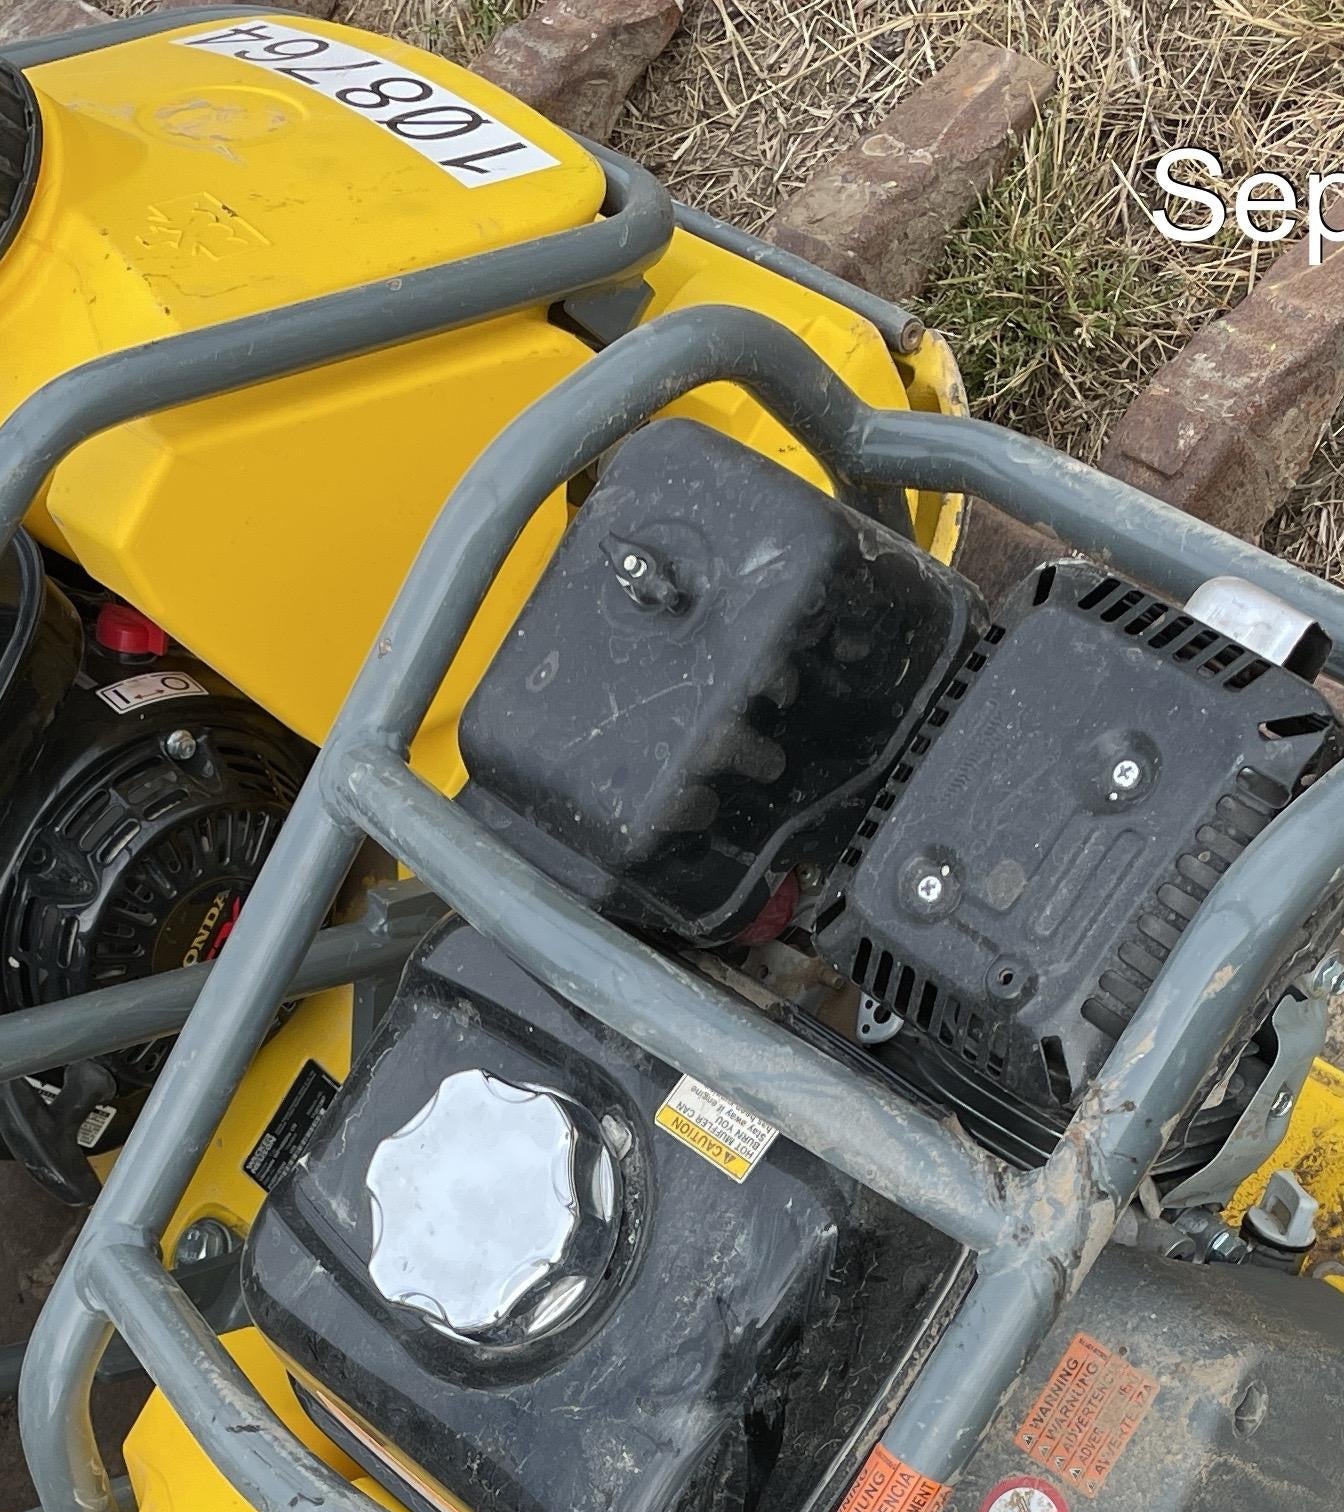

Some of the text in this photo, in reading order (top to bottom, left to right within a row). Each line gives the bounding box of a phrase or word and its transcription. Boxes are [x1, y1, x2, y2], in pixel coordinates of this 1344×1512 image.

[183, 888, 233, 968] ONDA
[690, 1085, 718, 1107] engine
[670, 1116, 723, 1157] CAUTION
[675, 1100, 755, 1159] HOT MUFFLER CAN
[724, 1108, 748, 1127] away
[746, 1124, 767, 1143] Stay
[734, 1128, 761, 1151] BURN
[1029, 1357, 1079, 1430] WARNING
[1045, 1361, 1099, 1440] WARNUNG
